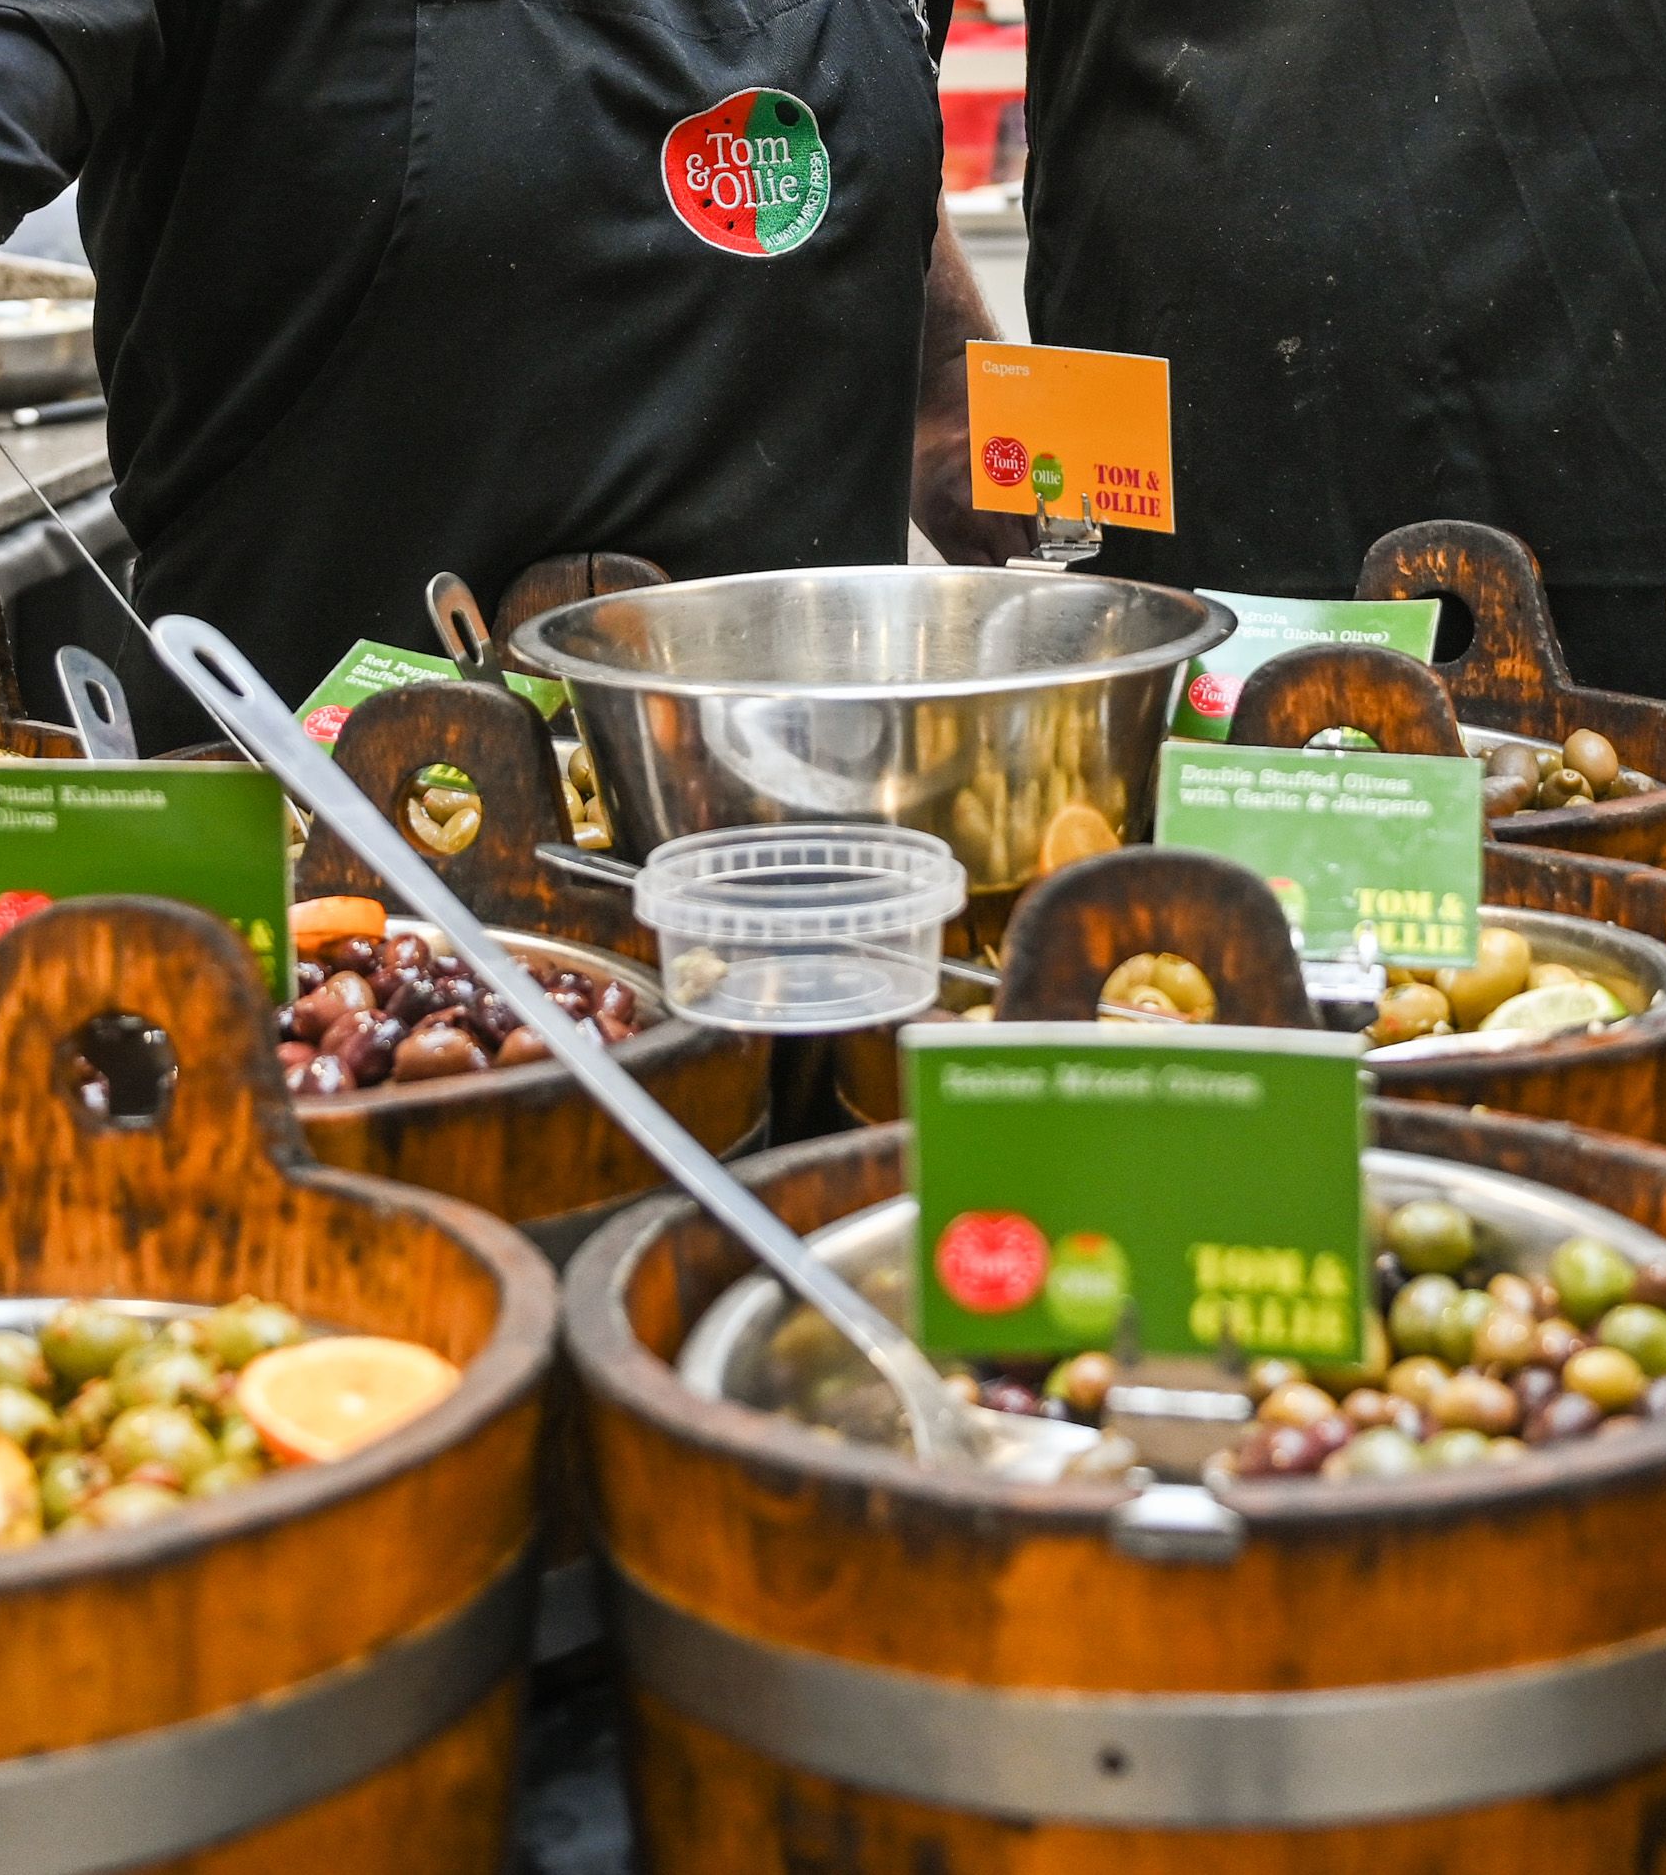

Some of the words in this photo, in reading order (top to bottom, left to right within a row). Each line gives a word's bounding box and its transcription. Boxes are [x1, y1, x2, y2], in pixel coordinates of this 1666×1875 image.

[706, 132, 793, 169] Tom
[685, 153, 711, 192] &
[711, 168, 800, 210] Ollie
[765, 222, 801, 249] ALWAYS
[796, 189, 822, 229] MARKET
[809, 150, 823, 189] FRESH
[981, 360, 1031, 377] Capers
[990, 454, 1020, 471] Tom
[1032, 469, 1062, 486] Ollie
[1094, 463, 1141, 489] TOM
[1146, 470, 1160, 492] &
[1095, 490, 1161, 518] OLLIE
[1282, 627, 1335, 642] Global
[1339, 629, 1391, 644] Olive)
[361, 652, 392, 669] Red
[351, 663, 408, 687] Stuffed
[1180, 763, 1257, 788] Double
[1258, 767, 1339, 793] Stuffed
[1342, 772, 1413, 796] Olives
[1180, 786, 1230, 809] with
[1233, 788, 1303, 812] Garlic
[1353, 886, 1435, 922] TOM
[1438, 891, 1467, 923] &
